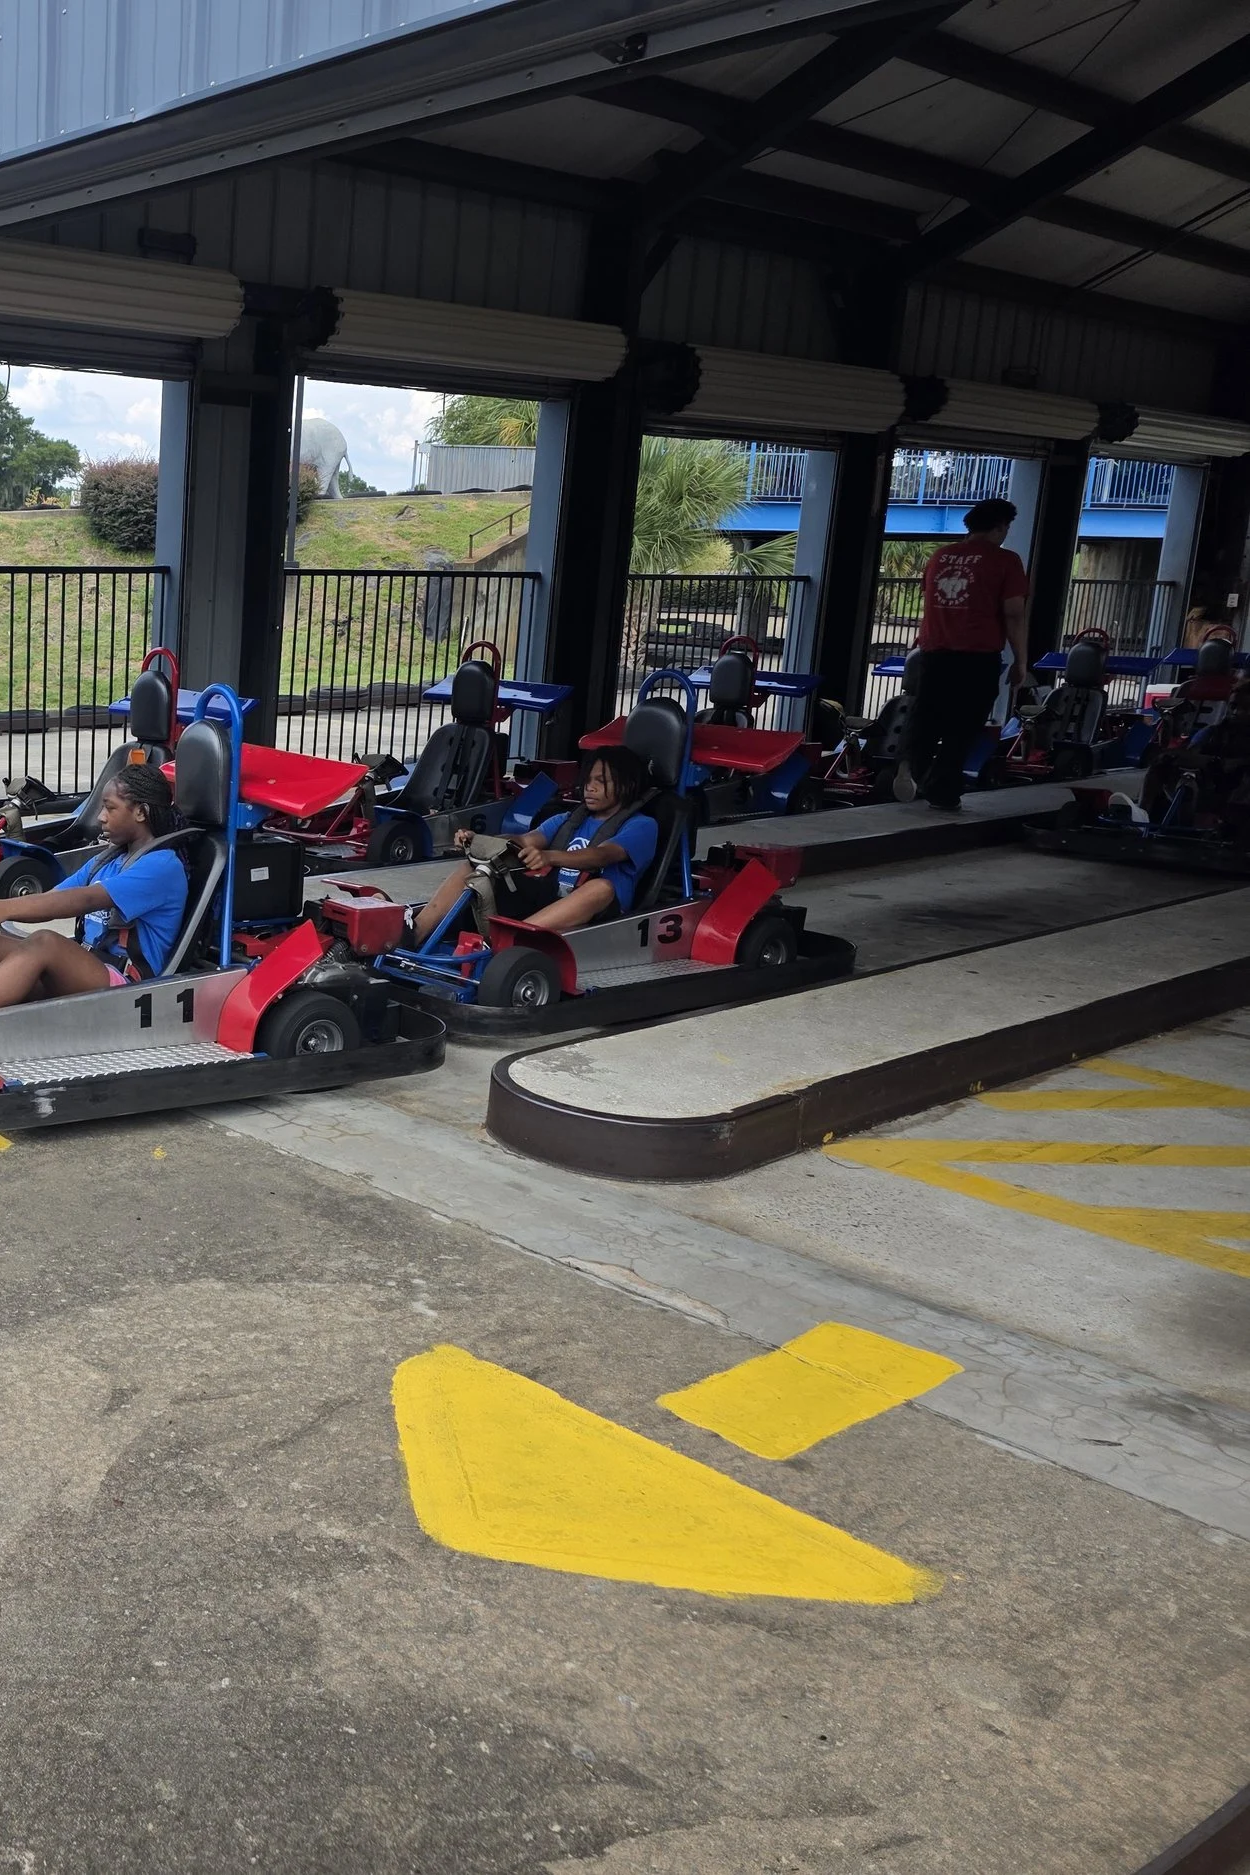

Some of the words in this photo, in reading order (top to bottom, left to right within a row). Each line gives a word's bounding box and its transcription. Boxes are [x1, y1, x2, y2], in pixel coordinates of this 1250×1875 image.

[939, 554, 983, 564] STAFF
[948, 592, 970, 606] PARK
[470, 813, 487, 834] 6
[637, 914, 683, 947] 13
[134, 988, 194, 1029] 11
